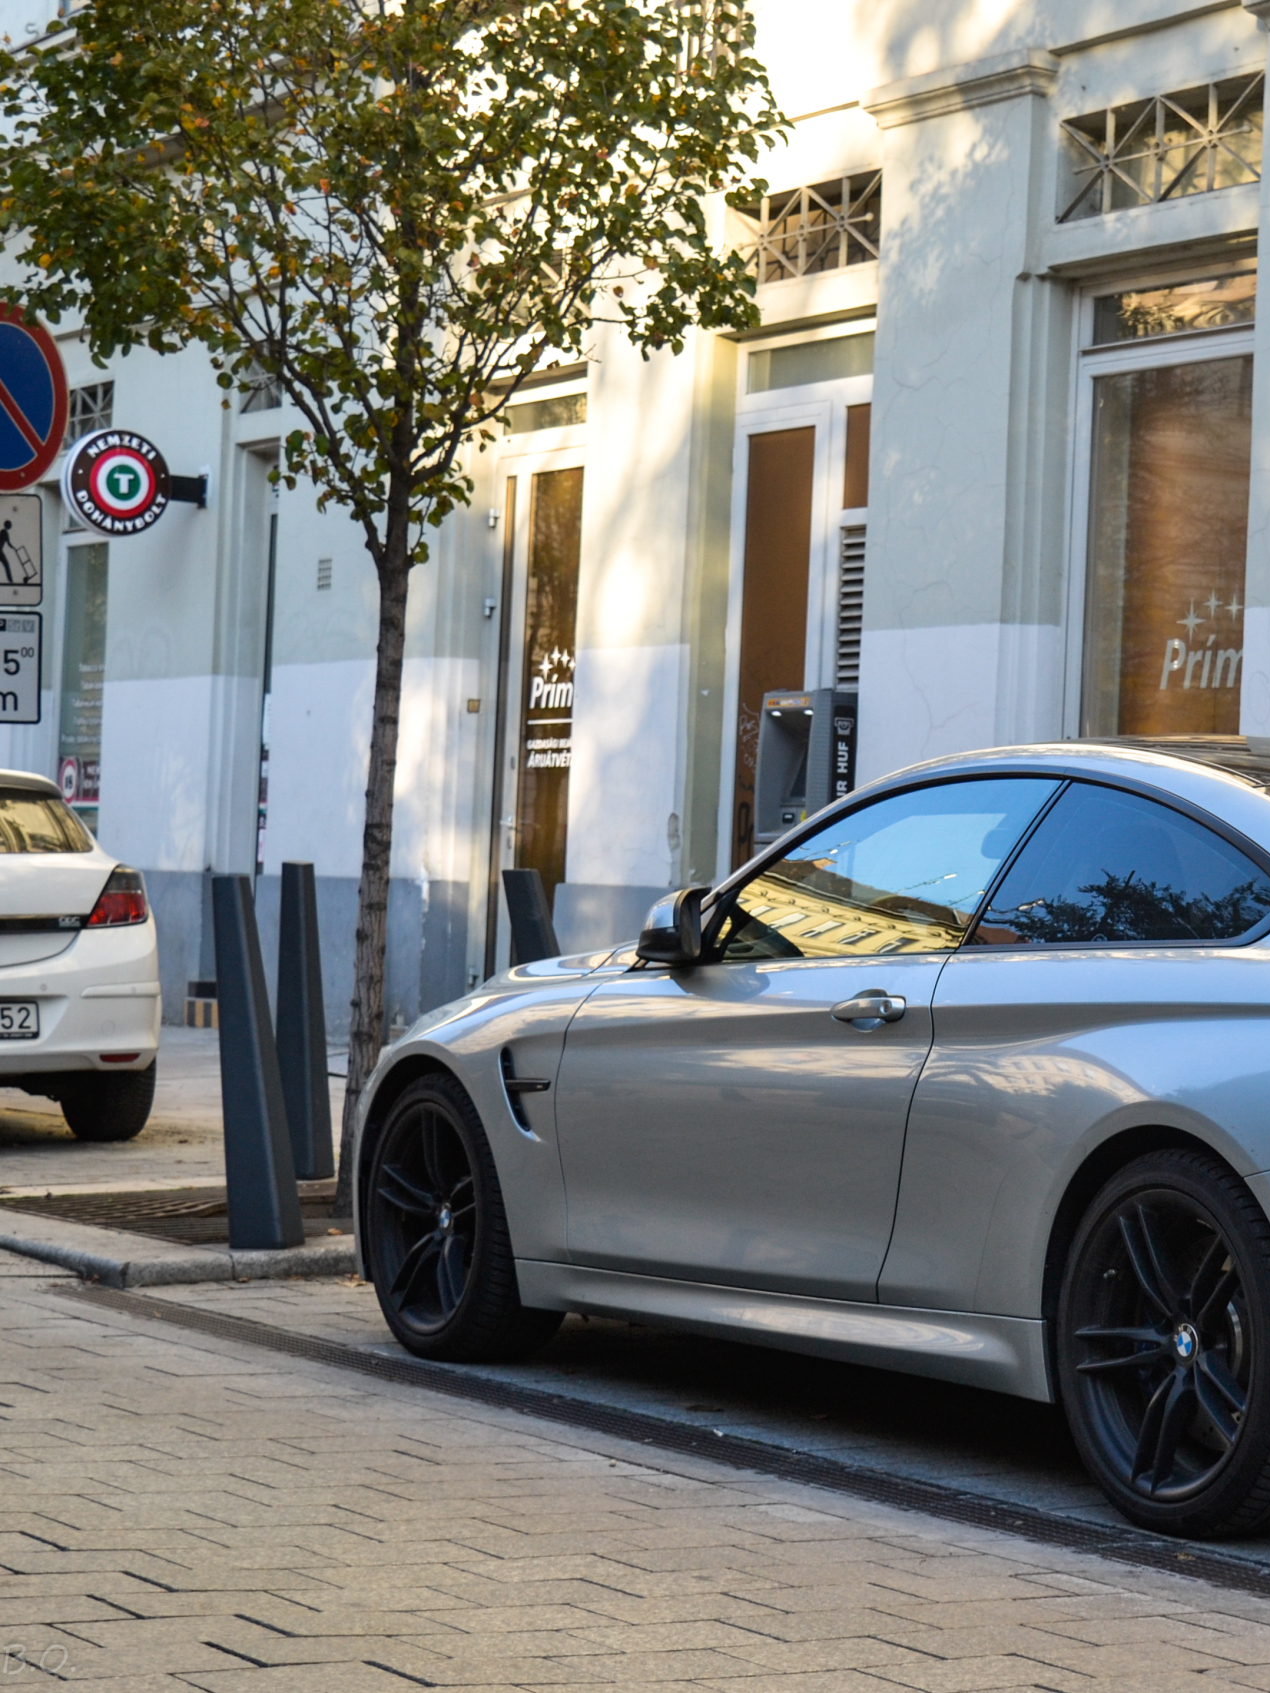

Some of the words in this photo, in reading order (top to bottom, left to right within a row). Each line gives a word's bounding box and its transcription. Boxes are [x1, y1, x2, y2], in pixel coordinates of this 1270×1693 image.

[86, 433, 157, 460] NEMZETI
[113, 472, 135, 494] T
[76, 489, 167, 532] DOHÁNYBOLT
[529, 673, 574, 709] Prím
[837, 741, 849, 774] HUF
